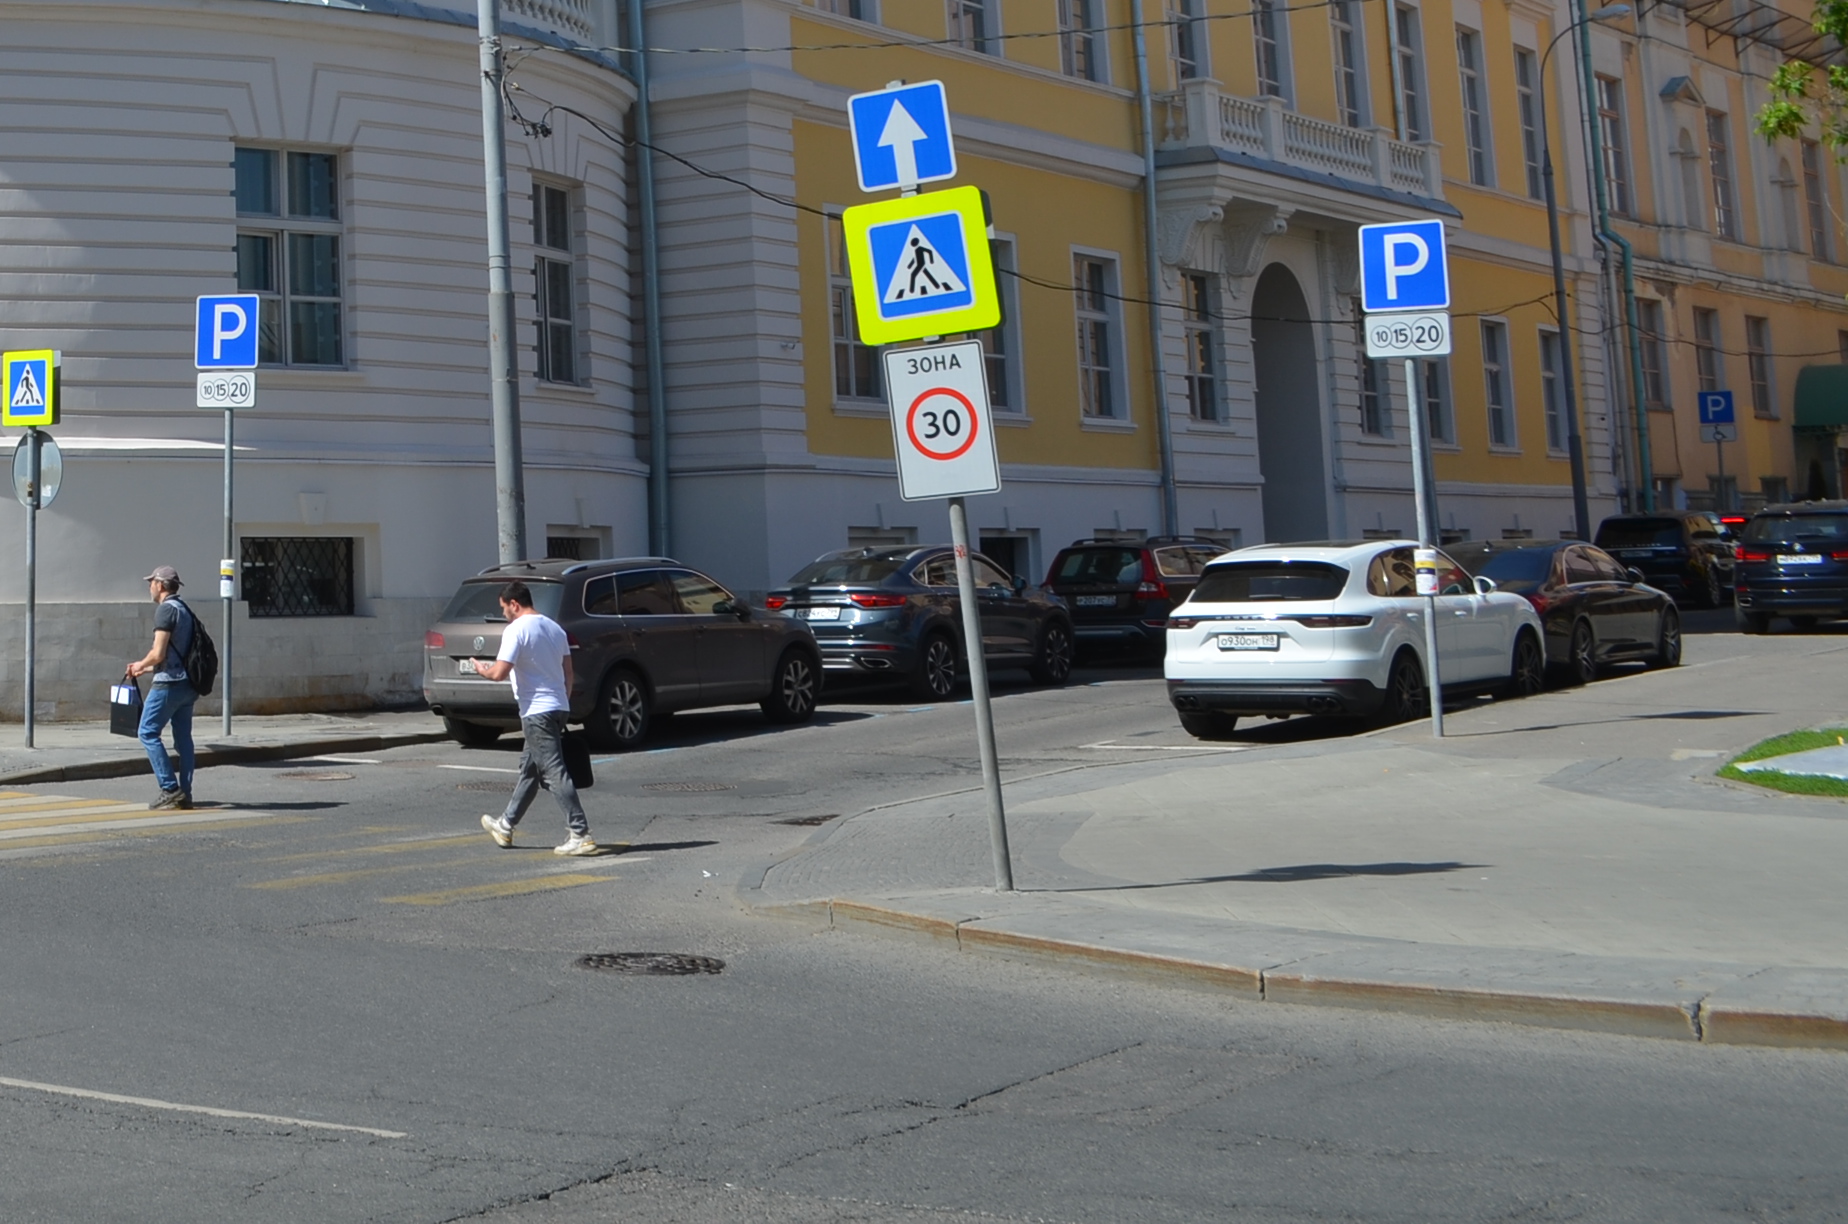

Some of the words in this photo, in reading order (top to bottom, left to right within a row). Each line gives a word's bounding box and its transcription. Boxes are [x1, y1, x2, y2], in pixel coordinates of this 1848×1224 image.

[1383, 232, 1430, 301] P
[212, 303, 248, 360] P
[1376, 330, 1389, 344] 10
[1393, 327, 1409, 344] 15
[1415, 325, 1440, 344] 20
[906, 353, 962, 375] ЗОНА
[203, 385, 213, 397] 10
[216, 383, 227, 397] 15
[231, 382, 248, 398] 20
[1707, 395, 1726, 420] P
[922, 408, 961, 439] 30
[1221, 636, 1258, 646] О930ОН
